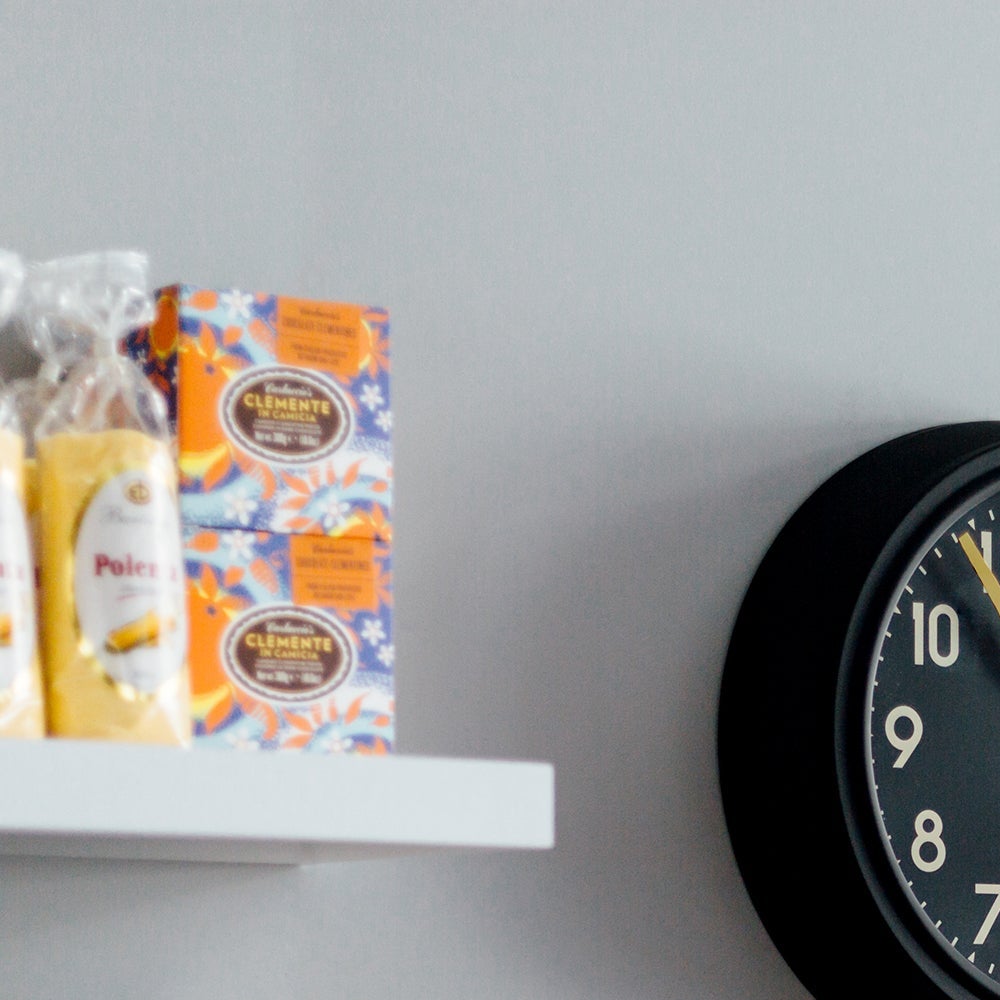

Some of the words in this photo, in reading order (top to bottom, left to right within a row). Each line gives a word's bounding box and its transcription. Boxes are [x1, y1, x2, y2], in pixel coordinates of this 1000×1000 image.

[243, 392, 330, 415] CLEMENTE
[258, 409, 269, 417] IN
[245, 633, 332, 654] CLEMENTE
[912, 602, 960, 668] 10
[260, 648, 271, 657] IN
[885, 706, 923, 769] 9
[910, 809, 946, 873] 8
